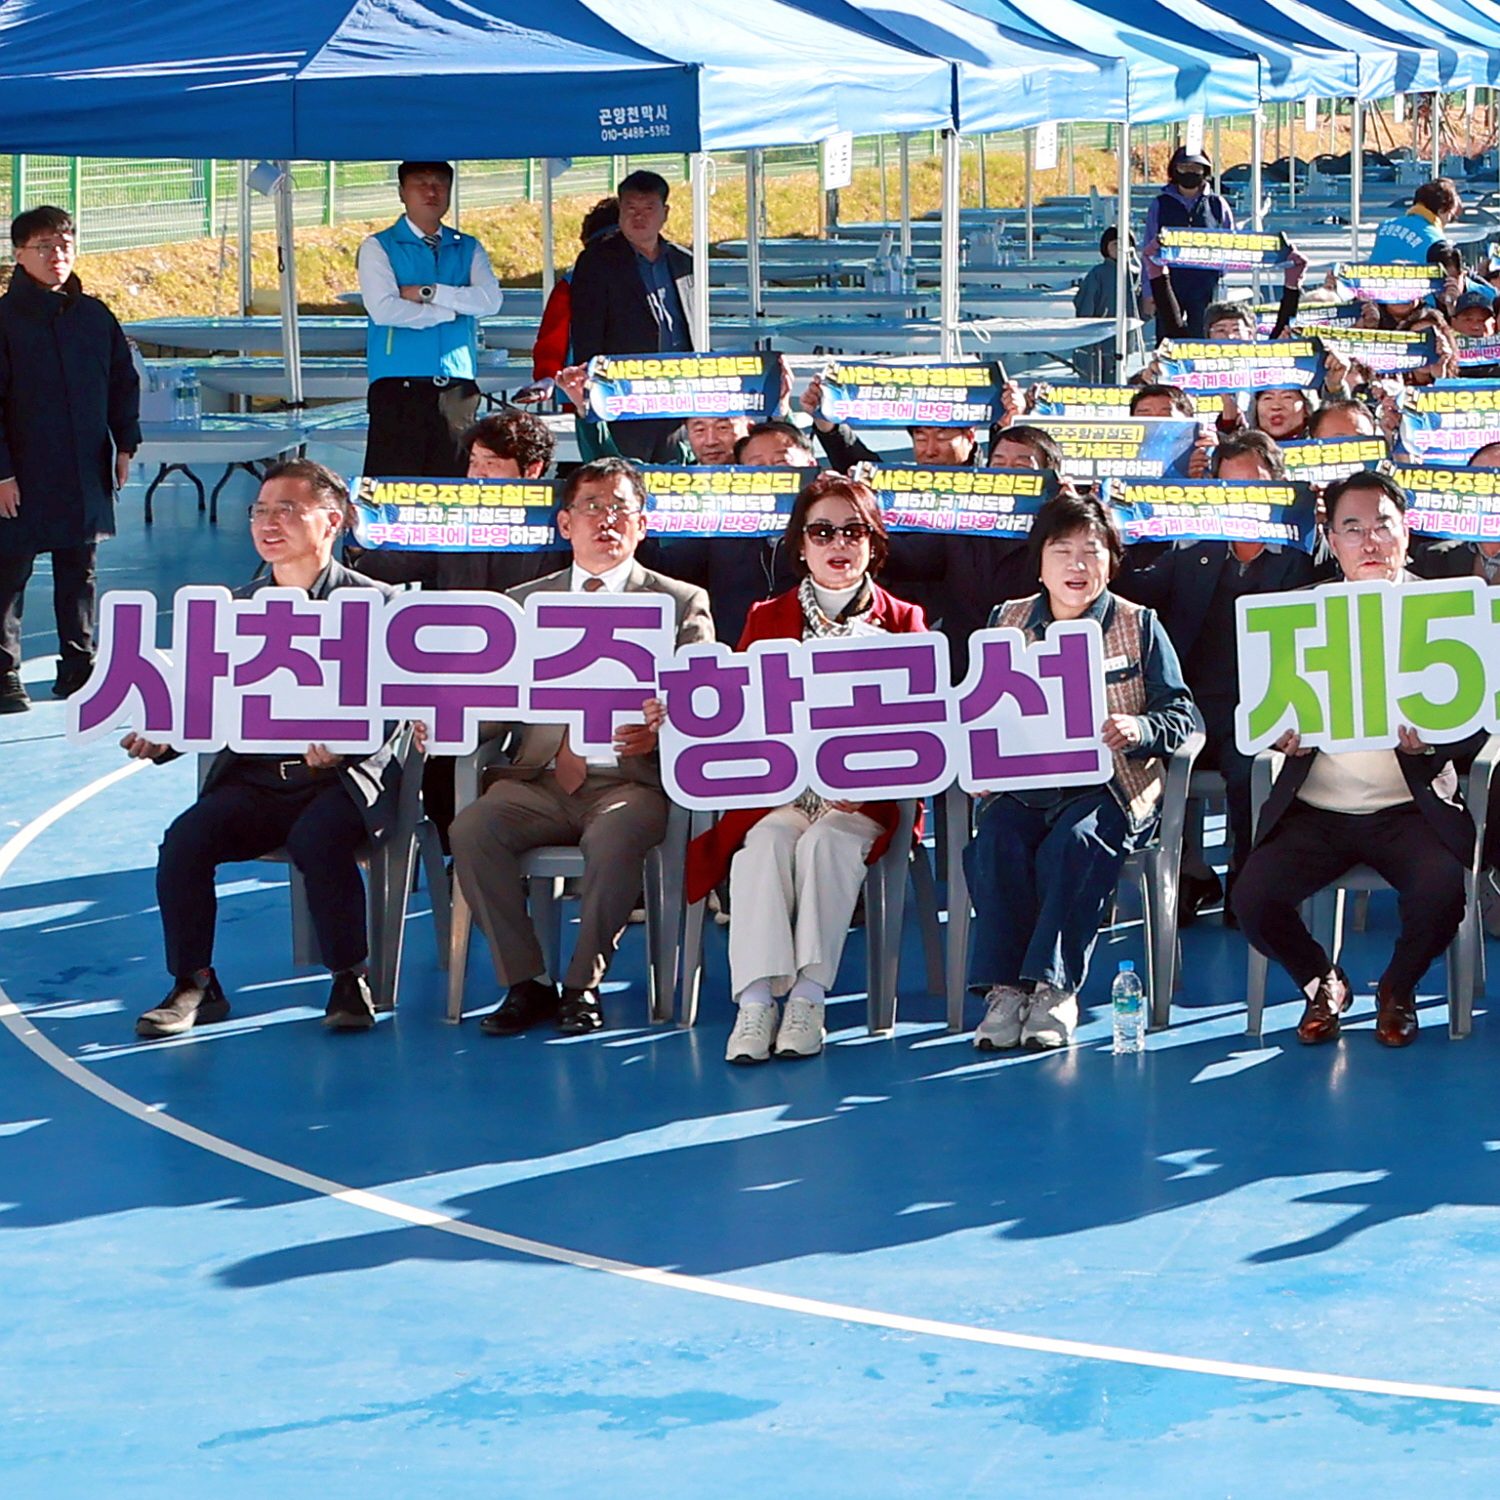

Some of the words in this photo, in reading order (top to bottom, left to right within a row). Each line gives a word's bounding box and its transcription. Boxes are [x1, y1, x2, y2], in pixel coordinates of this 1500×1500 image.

[599, 104, 668, 126] 곤양천막사
[606, 357, 763, 380] 사천우주항공철도!
[836, 365, 991, 386] 사천우주항공철도!
[631, 379, 672, 393] 제5차
[674, 377, 741, 391] 국가철도망
[857, 385, 897, 401] 제5차
[900, 384, 967, 401] 국가철도망
[606, 395, 692, 413] 구축계획에
[697, 393, 764, 412] 반영하라!
[834, 402, 912, 421] 구축계획에
[917, 400, 992, 422] 반영하라!
[1440, 412, 1480, 427] 제5차
[647, 471, 798, 494] 천우주항공철도!
[870, 471, 1042, 496] 사천우주항공철도!
[370, 484, 553, 506] 사천우주항공철도!
[655, 496, 699, 512] 제5차
[702, 494, 775, 512] 국가철도망
[893, 494, 936, 508] 제5차
[938, 493, 1015, 510] 국가철도망
[1124, 484, 1294, 506] 사천우주항공철도!
[1414, 493, 1459, 508] 제5차
[399, 507, 445, 524] 제5차
[447, 506, 525, 524] 국가철도망
[882, 512, 954, 528] 축계획에
[1152, 504, 1197, 518] 제5차
[1200, 504, 1271, 519] 국가철도망
[1405, 509, 1477, 533] 축계획에
[647, 513, 717, 532] 축계획에
[1126, 519, 1220, 537] 구축계획에
[1222, 518, 1299, 541] 반영하라!
[368, 525, 466, 546] 구축계획에
[471, 525, 554, 546] 반영하라!
[79, 600, 661, 743] 사천우주
[659, 633, 1100, 798] 항공선
